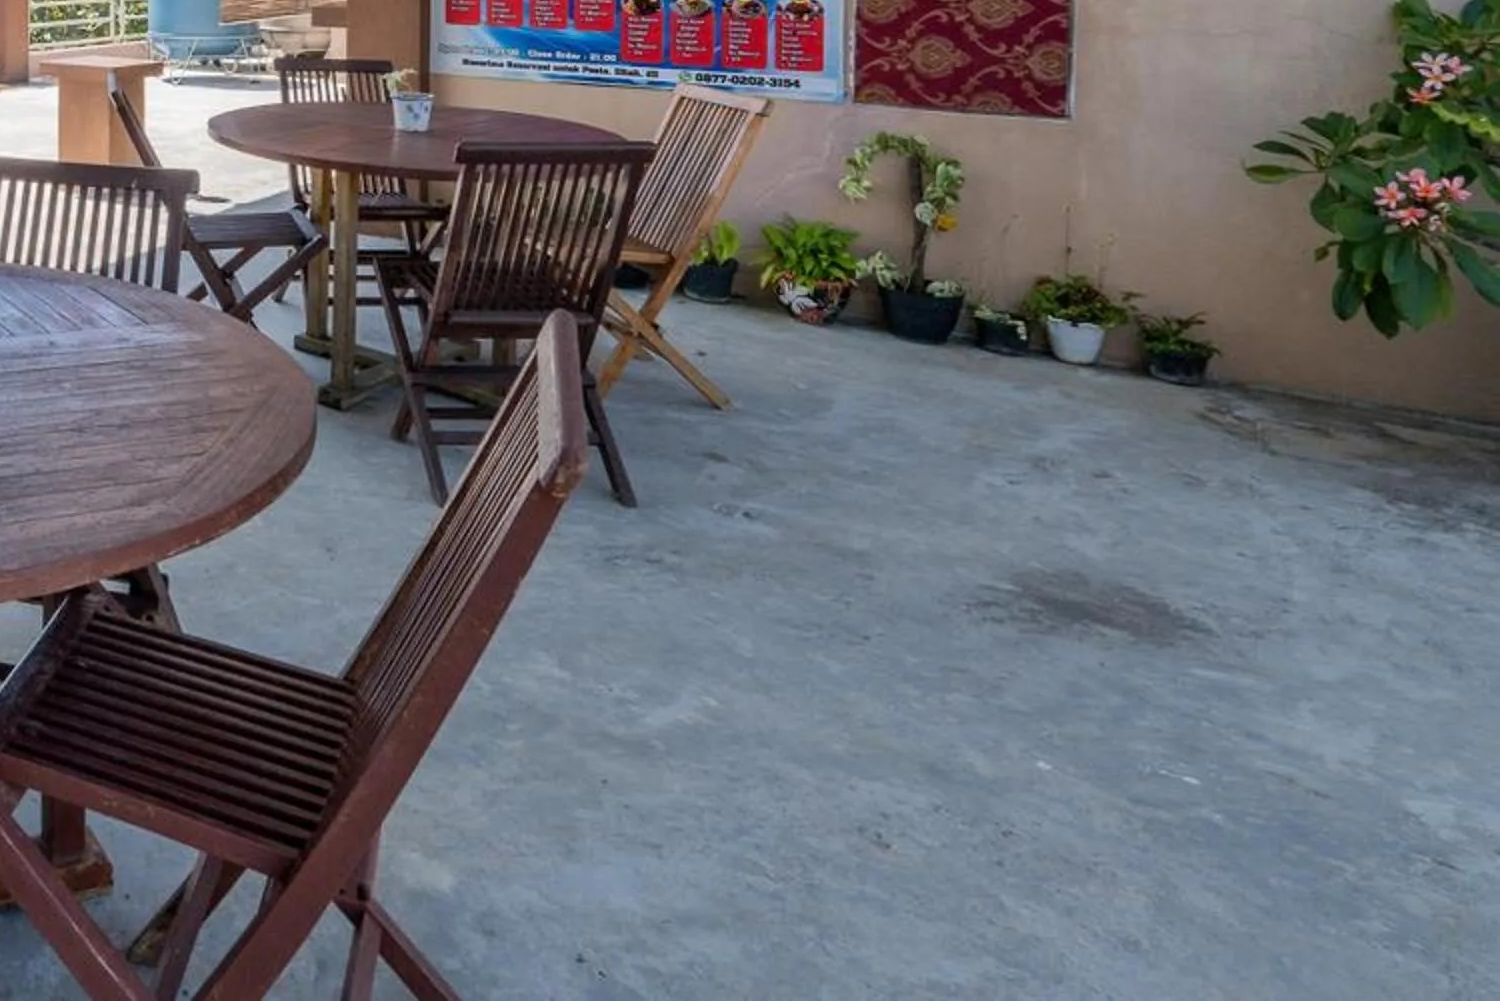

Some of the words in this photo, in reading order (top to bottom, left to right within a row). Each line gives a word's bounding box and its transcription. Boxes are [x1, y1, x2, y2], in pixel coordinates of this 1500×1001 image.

[527, 50, 553, 59] Close
[553, 63, 580, 73] untuk
[694, 72, 802, 89] 0877-0202-3154
